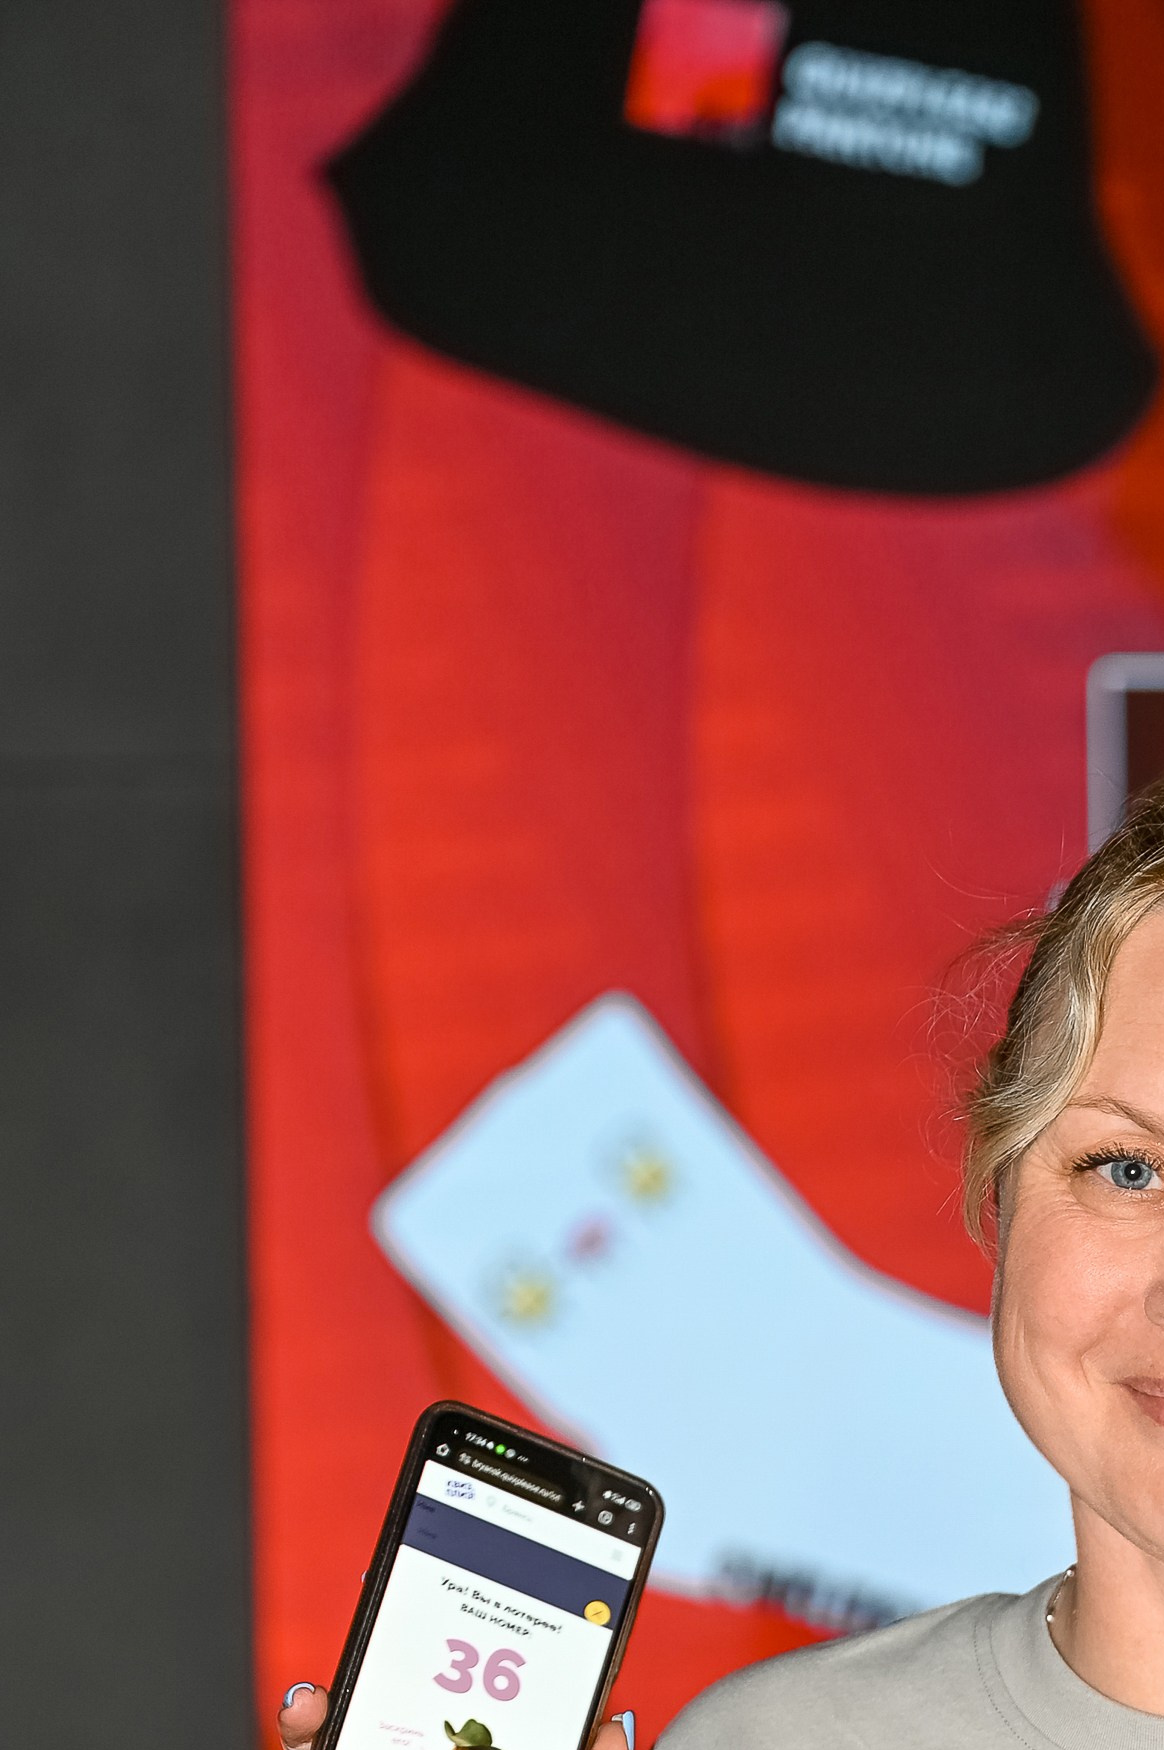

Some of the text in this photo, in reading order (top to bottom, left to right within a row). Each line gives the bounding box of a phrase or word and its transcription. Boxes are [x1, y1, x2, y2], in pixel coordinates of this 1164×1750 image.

[441, 1576, 469, 1596] Ура!
[472, 1590, 491, 1604] Вы
[504, 1605, 563, 1634] лотерее!
[460, 1603, 486, 1621] ВАШ
[432, 1638, 526, 1702] 36
